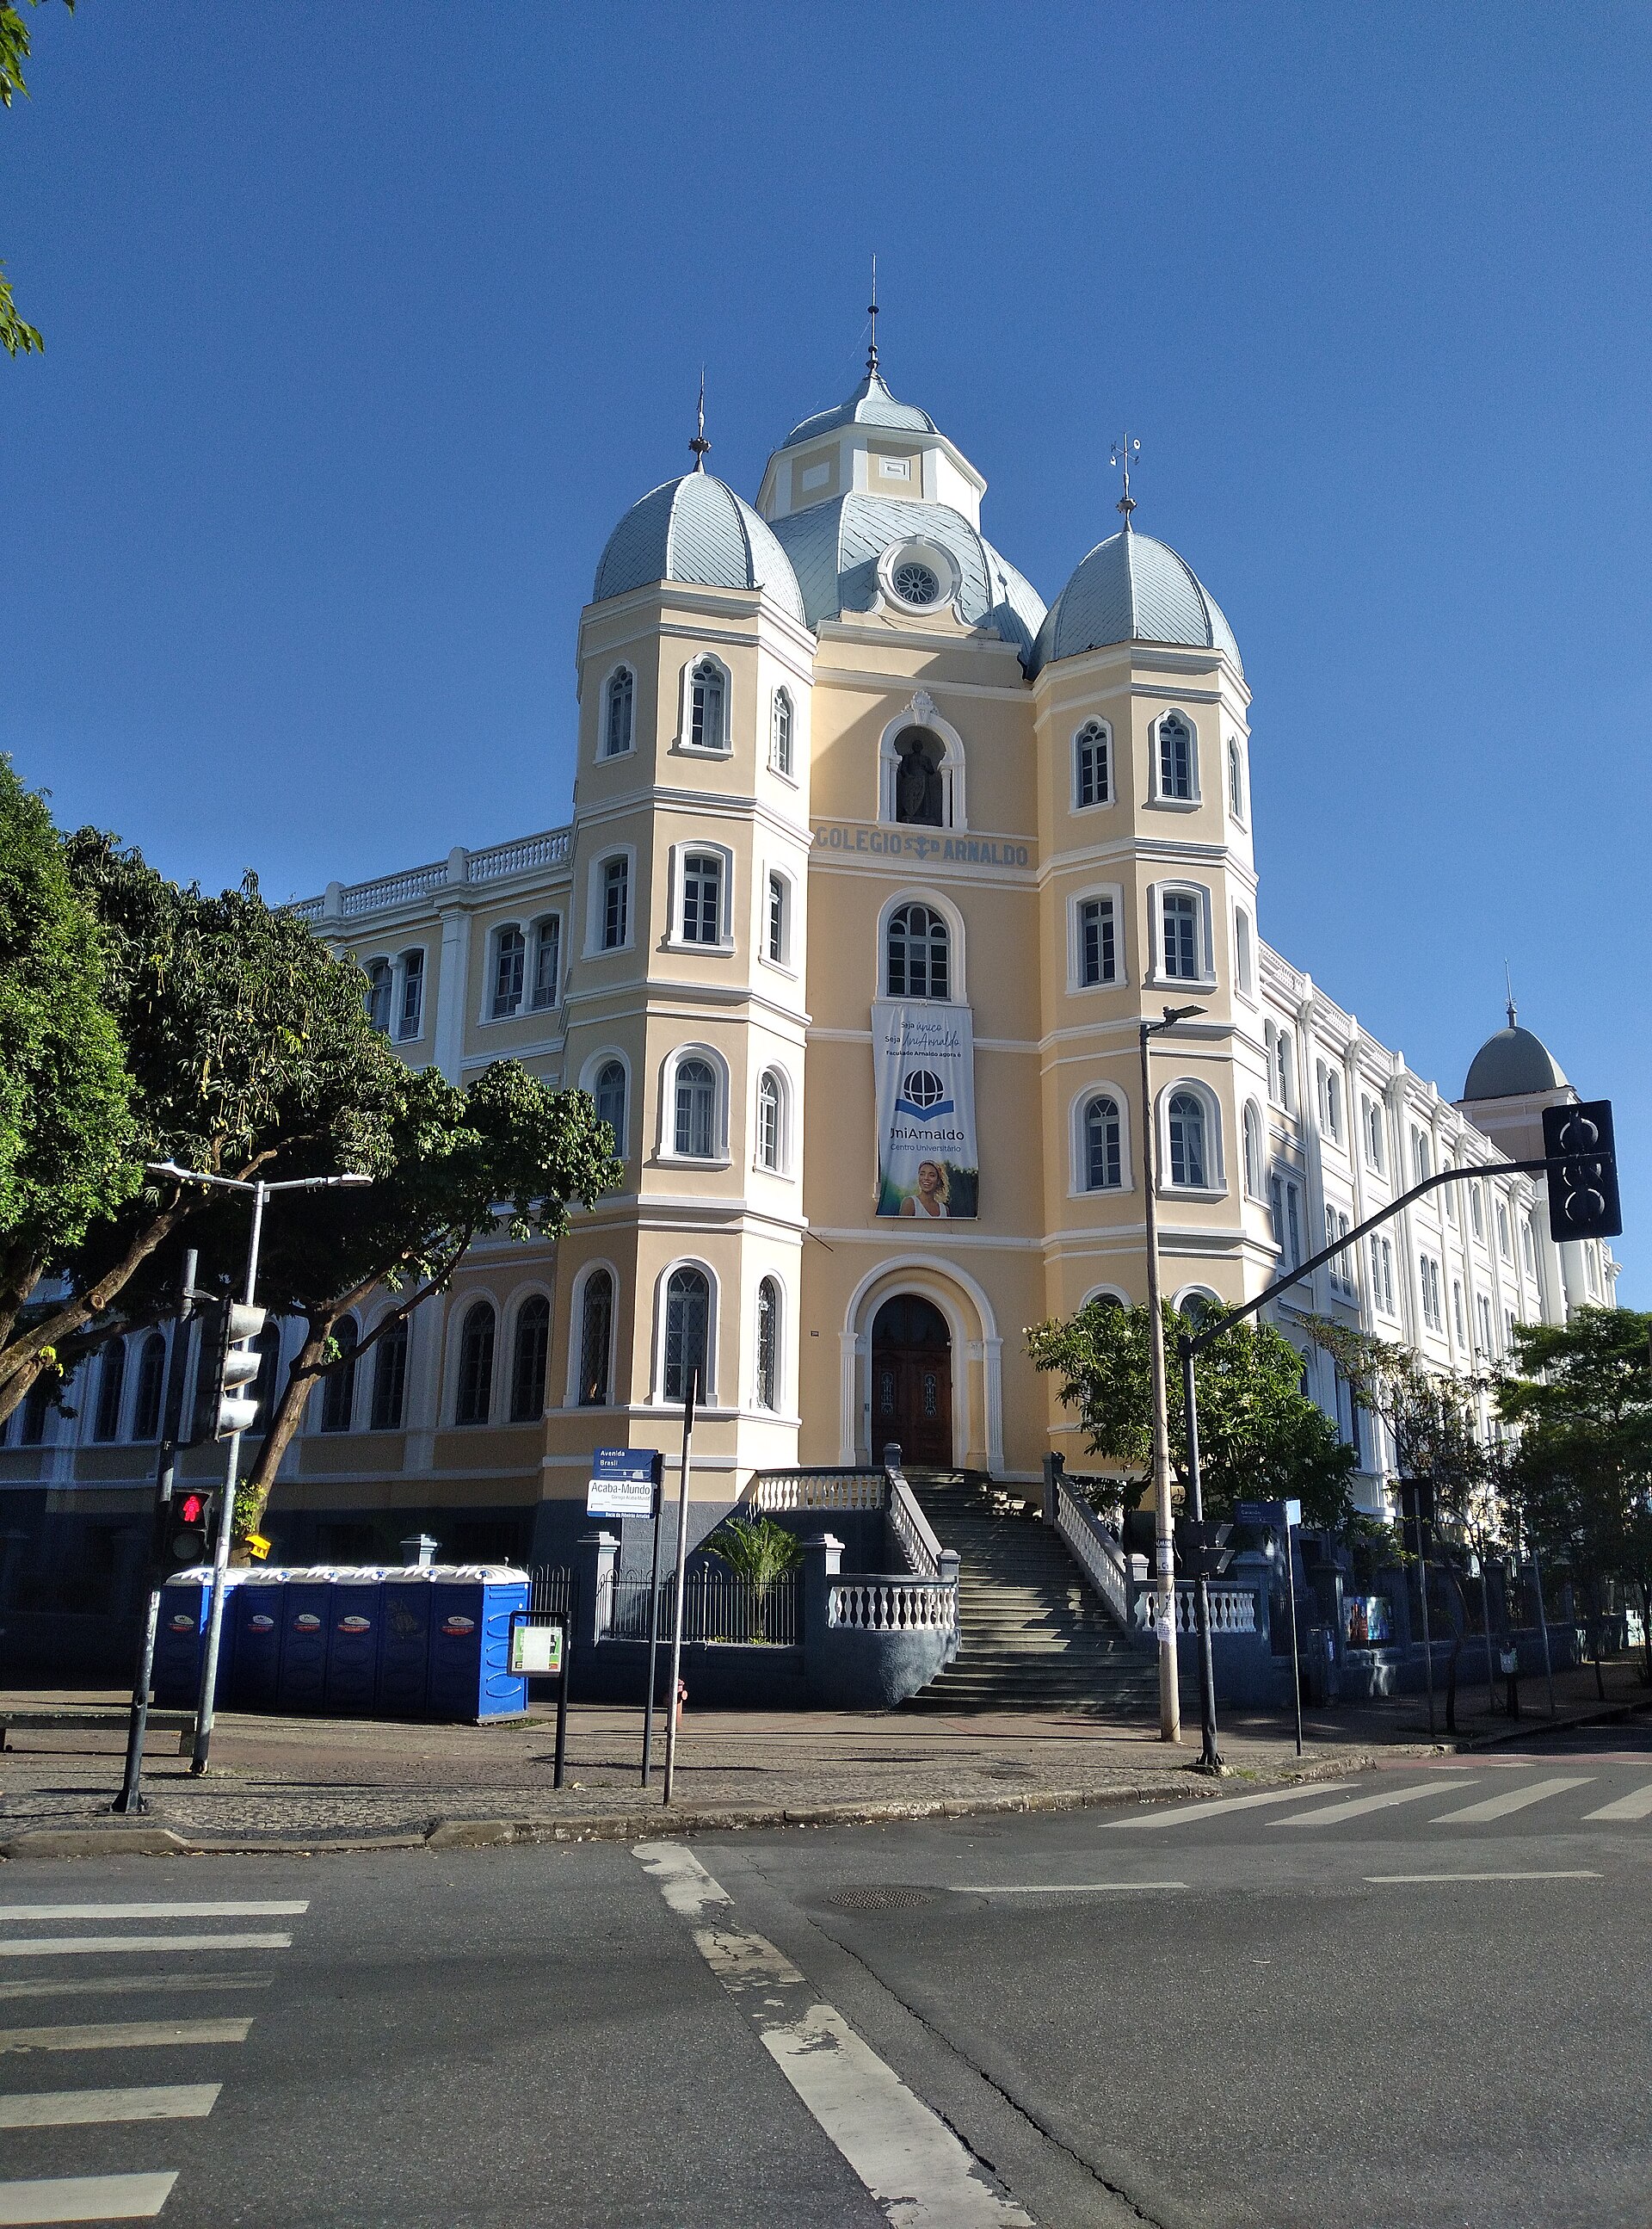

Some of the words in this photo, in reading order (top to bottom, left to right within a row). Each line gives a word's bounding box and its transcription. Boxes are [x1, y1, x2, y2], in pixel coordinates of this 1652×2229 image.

[816, 826, 902, 855] COLEGIO
[943, 839, 1027, 867] ARNALDO
[885, 1035, 901, 1044] Seja
[890, 1127, 965, 1140] UniArnaldo
[591, 1482, 650, 1495] Acaba-Mundo
